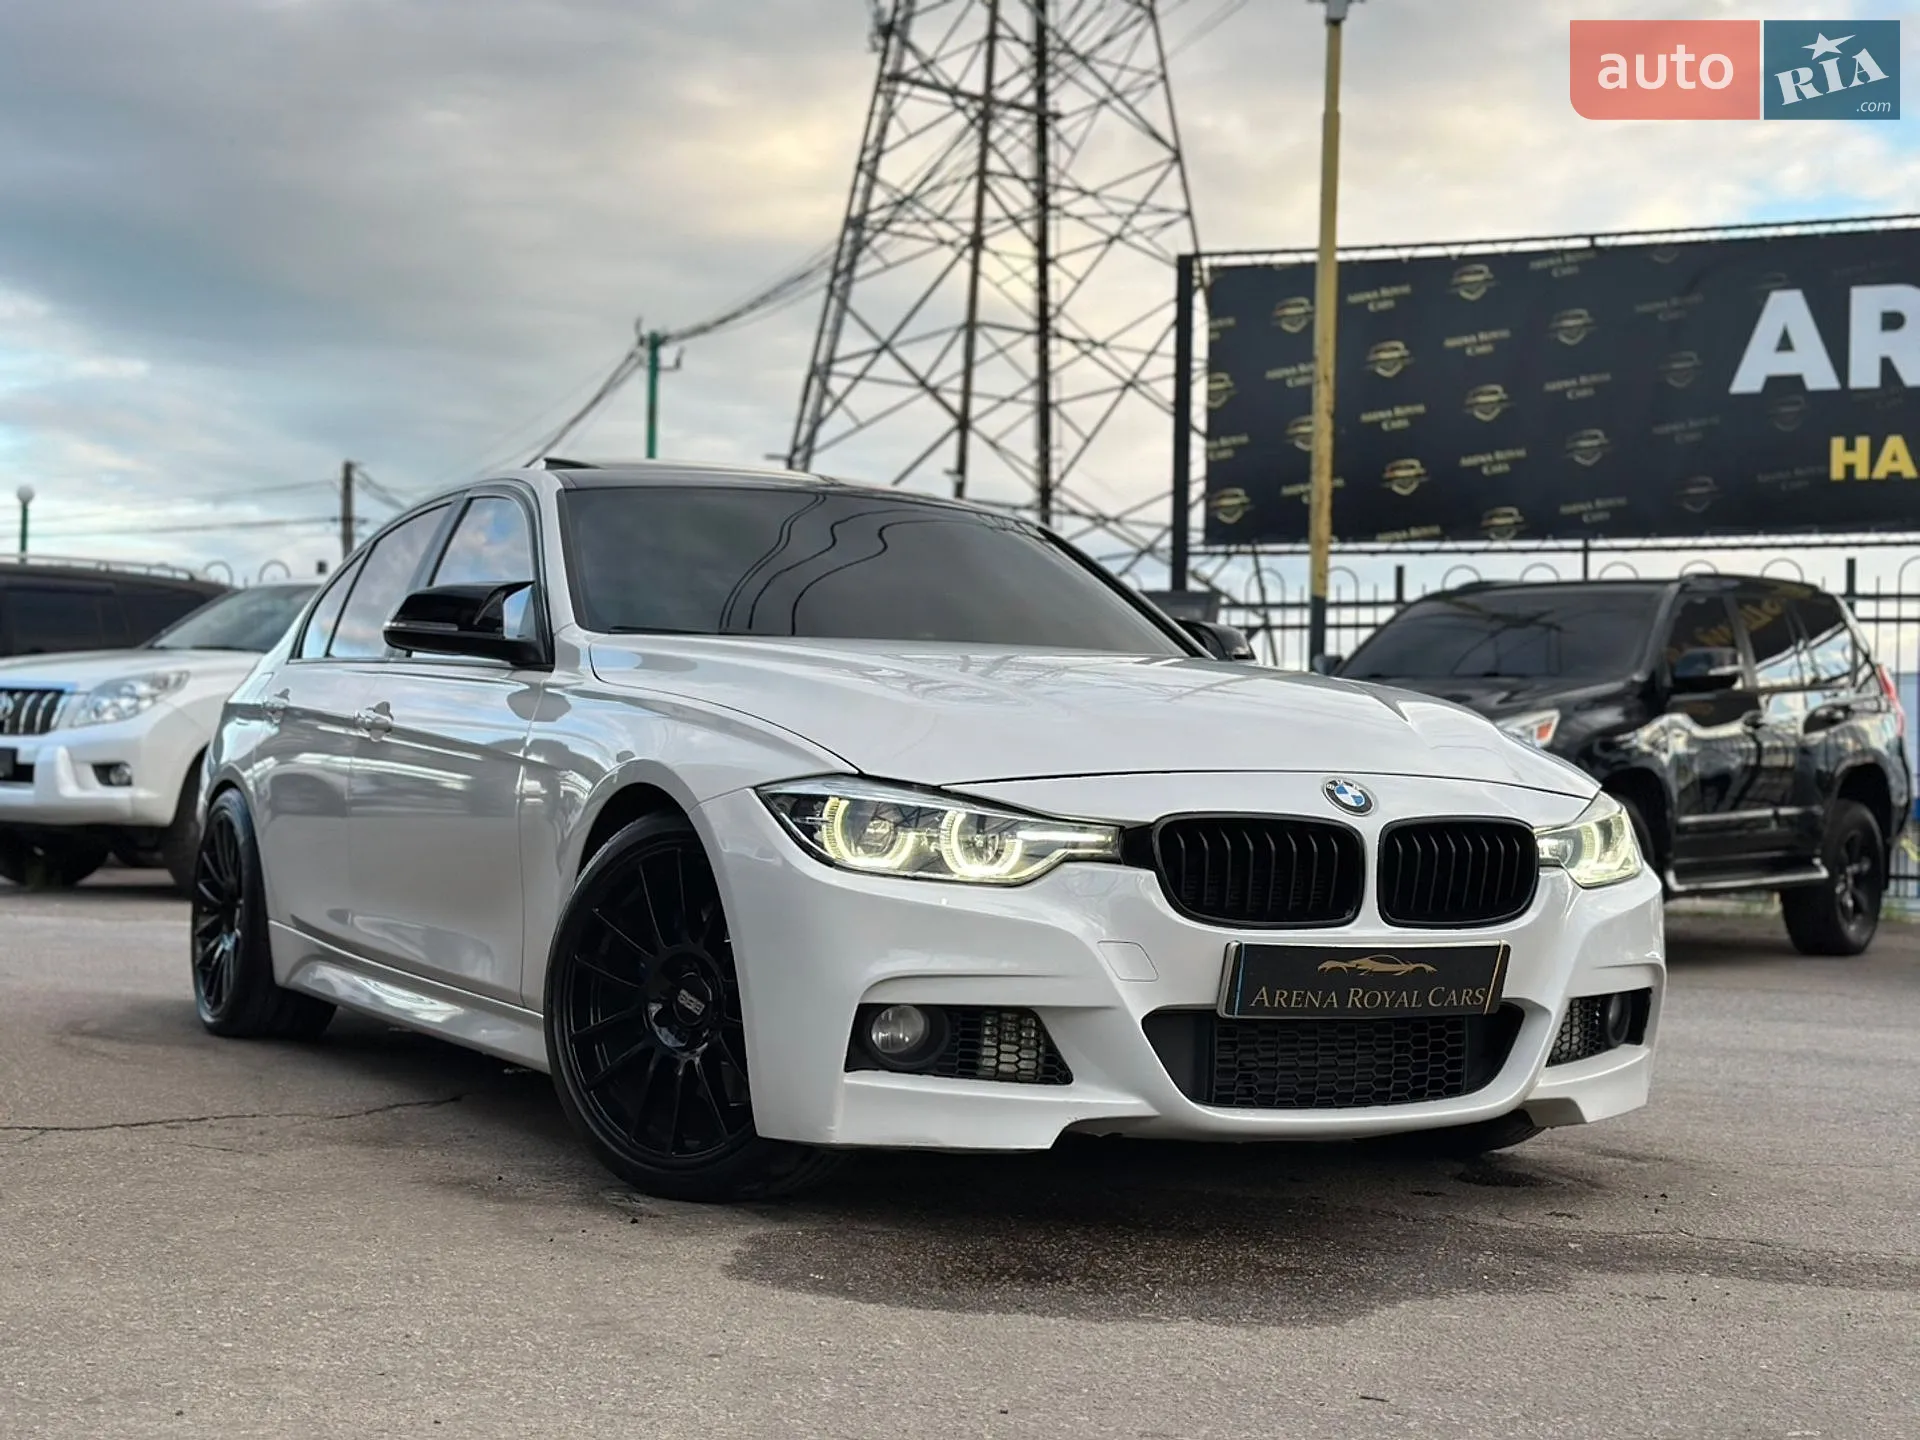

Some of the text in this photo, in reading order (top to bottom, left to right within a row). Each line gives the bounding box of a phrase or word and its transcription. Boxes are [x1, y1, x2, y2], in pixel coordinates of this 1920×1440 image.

[1728, 283, 1920, 395] AR
[1249, 986, 1486, 1009] ARENA ROYAL CARS
